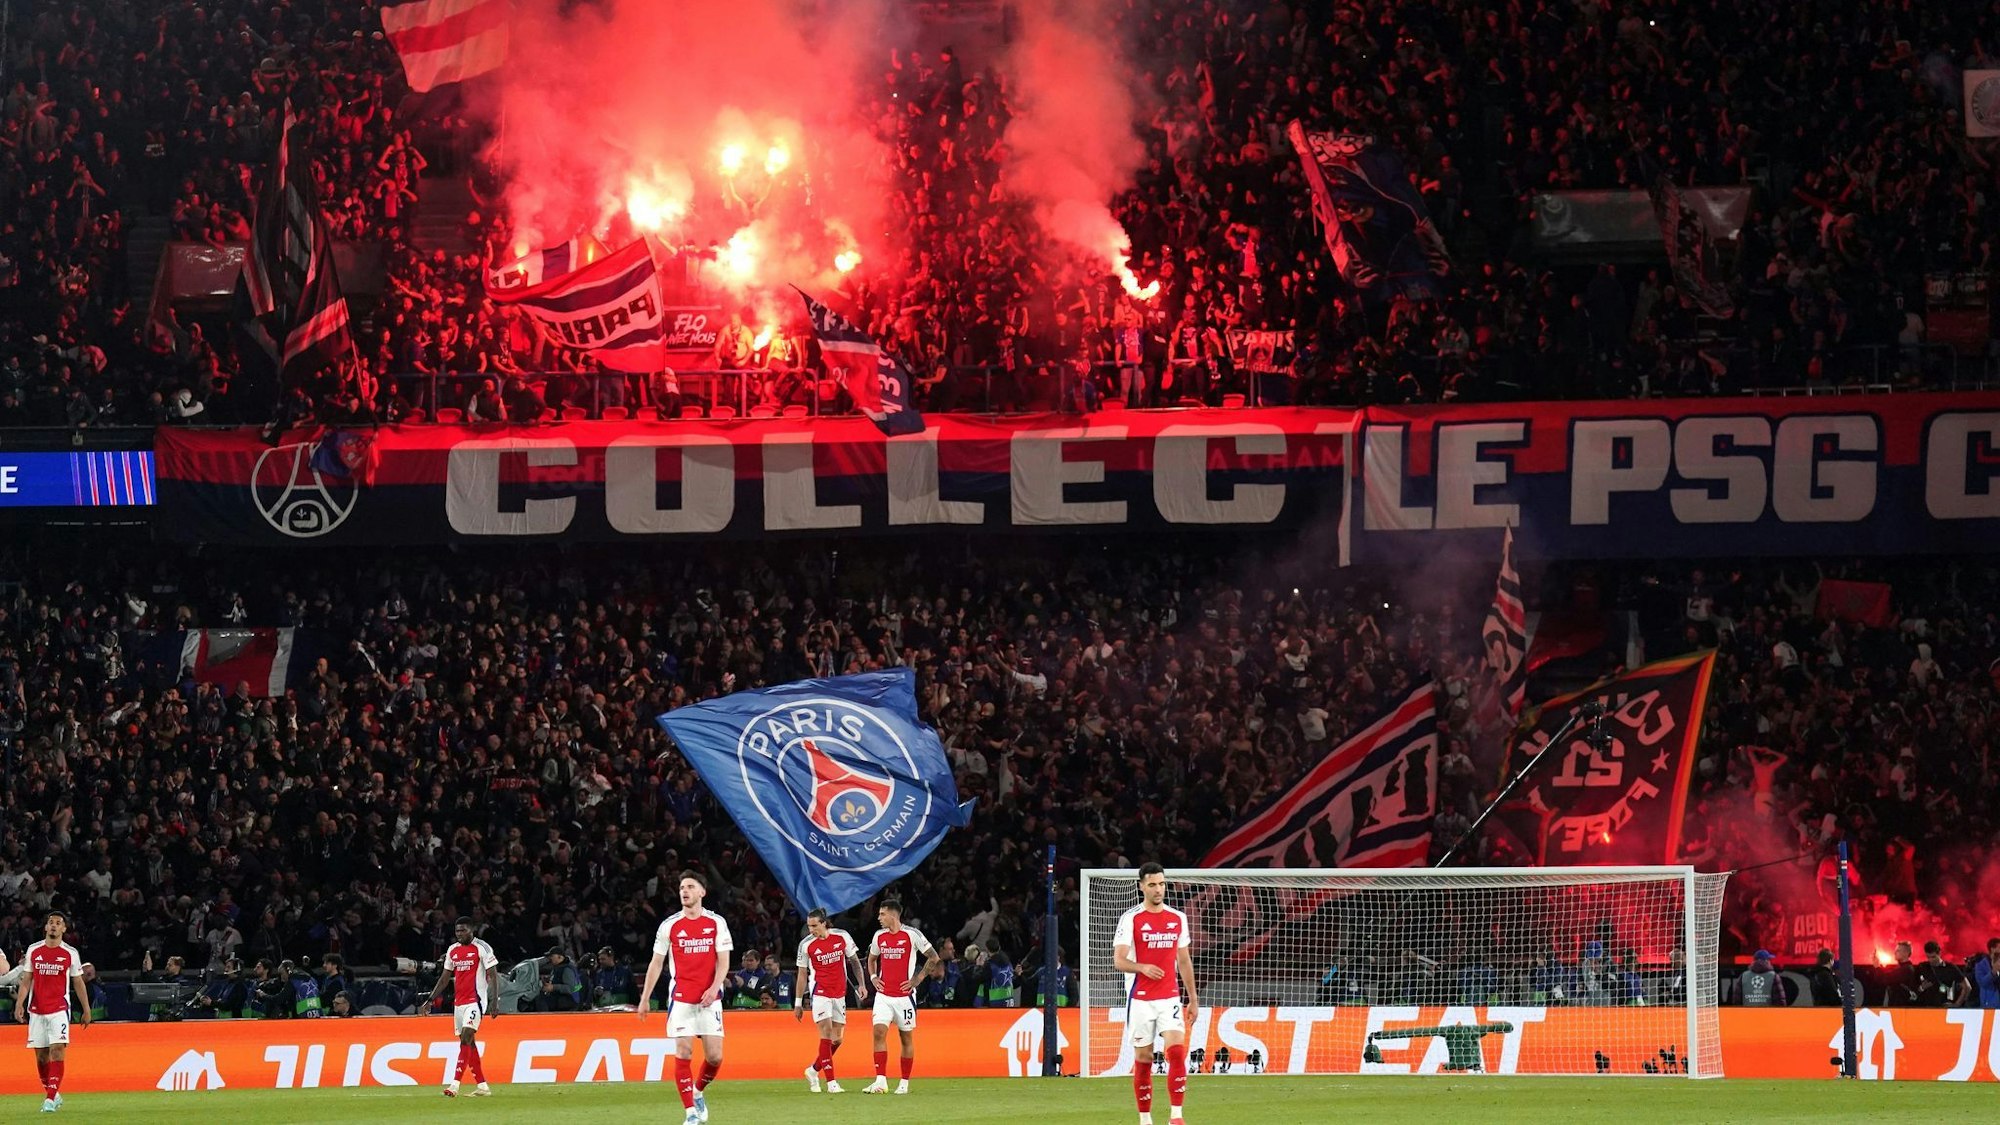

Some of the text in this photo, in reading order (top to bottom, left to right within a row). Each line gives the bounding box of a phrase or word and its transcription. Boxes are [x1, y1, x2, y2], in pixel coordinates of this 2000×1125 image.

[674, 313, 707, 333] FLO
[689, 330, 716, 346] NOUS
[1231, 331, 1296, 353] PARIS
[1363, 421, 1527, 532] LE
[1570, 413, 1879, 526] PSG
[748, 708, 865, 759] PARIS
[808, 795, 916, 858] SAINT GERMAIN
[678, 937, 714, 947] Emirates
[1141, 932, 1178, 942] Emirates
[816, 950, 844, 962] Emirates
[35, 962, 65, 971] Emirates
[469, 1009, 477, 1020] 5
[903, 1008, 913, 1020] 15
[61, 1023, 67, 1034] 2
[1360, 1006, 1547, 1075] EAT
[263, 1037, 677, 1089] JUST EAT
